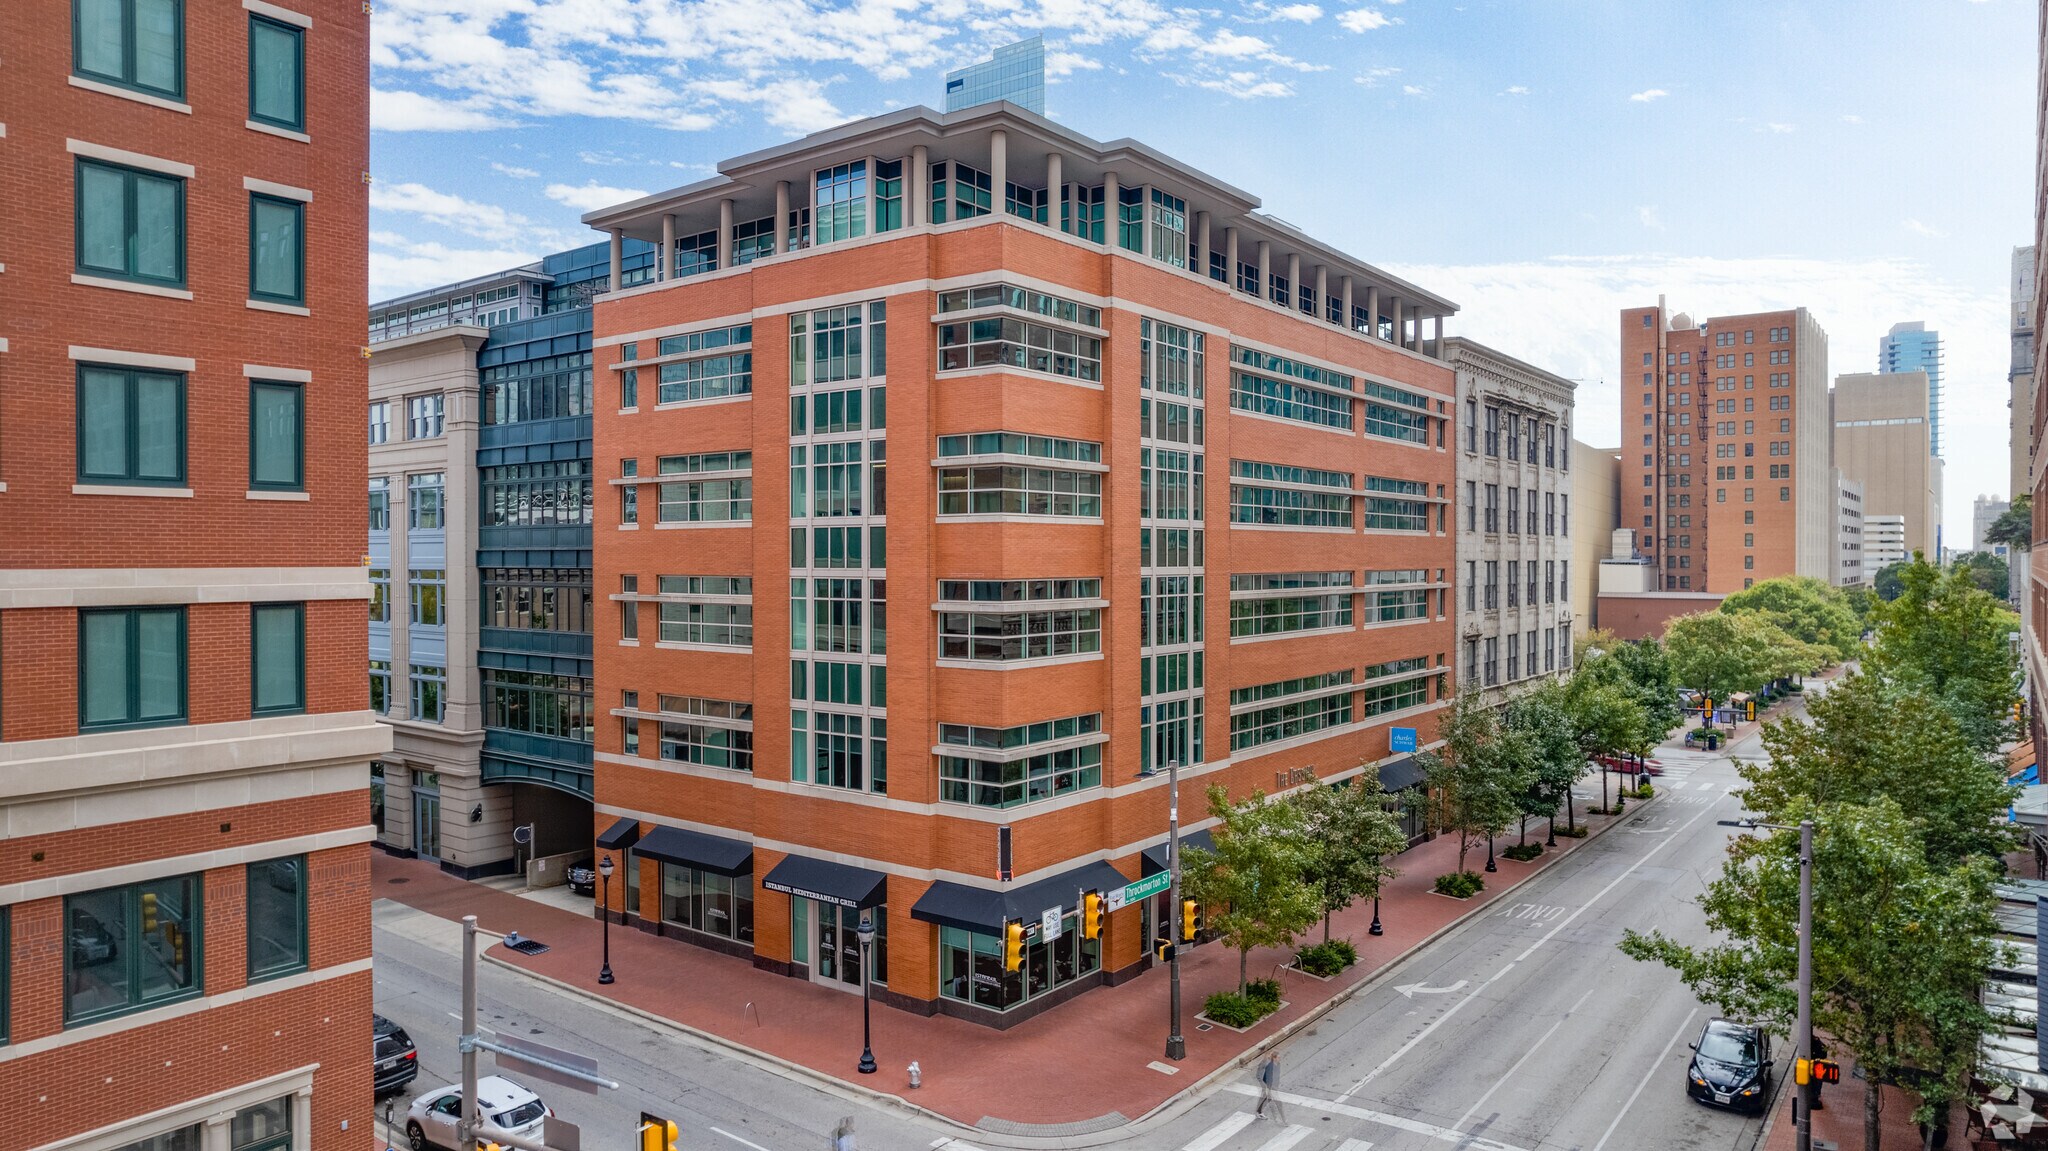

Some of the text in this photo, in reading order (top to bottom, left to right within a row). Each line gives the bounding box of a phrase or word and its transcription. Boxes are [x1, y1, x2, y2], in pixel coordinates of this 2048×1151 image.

[765, 881, 857, 908] ISTANBUL MEDITERRANEAN GRILL
[1126, 873, 1169, 898] Throckmorton St
[1495, 902, 1566, 921] ONLY
